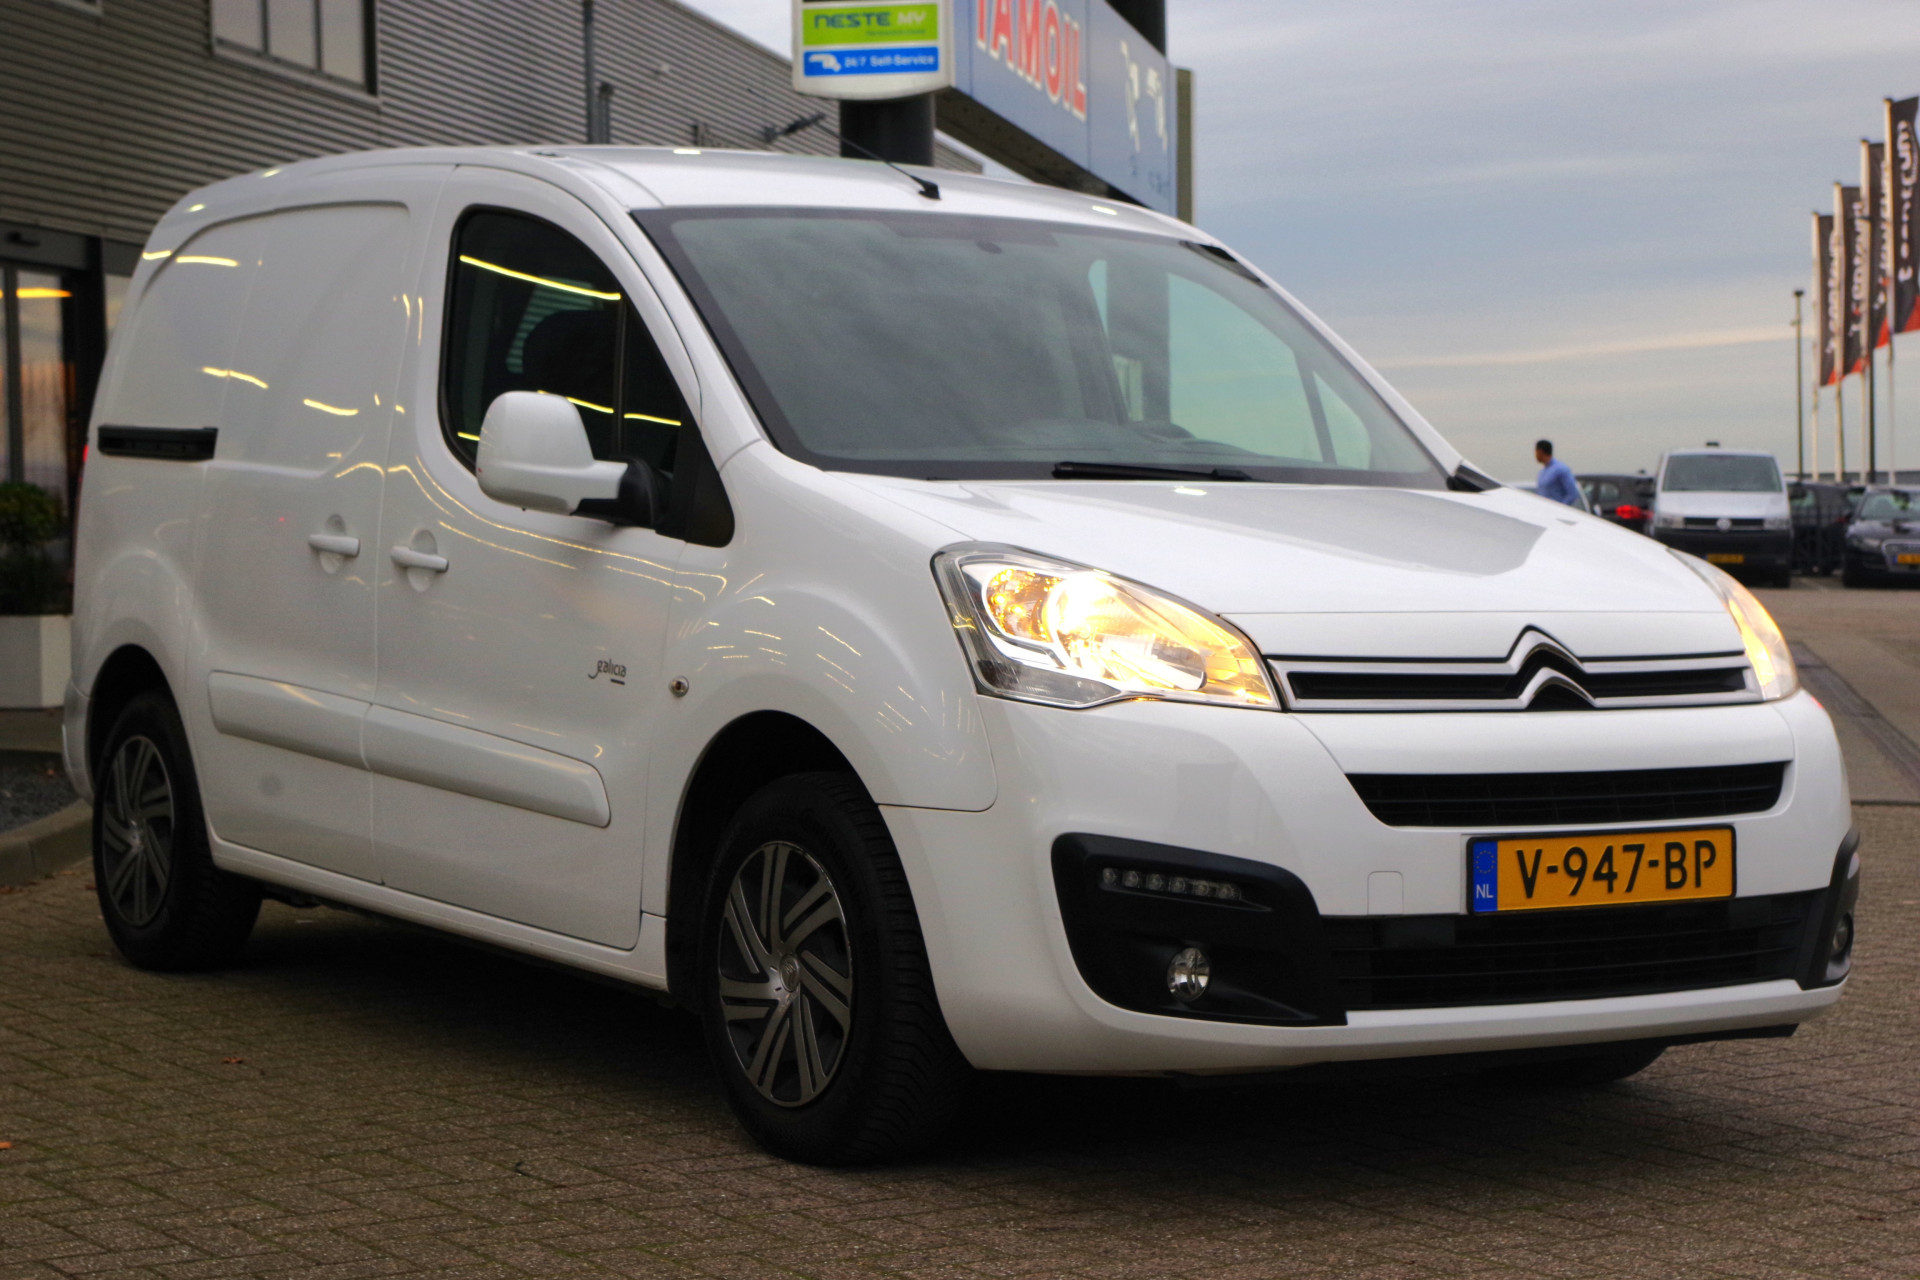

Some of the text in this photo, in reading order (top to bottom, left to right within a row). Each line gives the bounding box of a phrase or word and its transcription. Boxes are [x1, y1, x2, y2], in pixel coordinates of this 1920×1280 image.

[814, 11, 891, 29] NESTE
[588, 658, 627, 679] galicia
[1516, 840, 1716, 898] V-947-BP
[1476, 884, 1493, 898] NL
